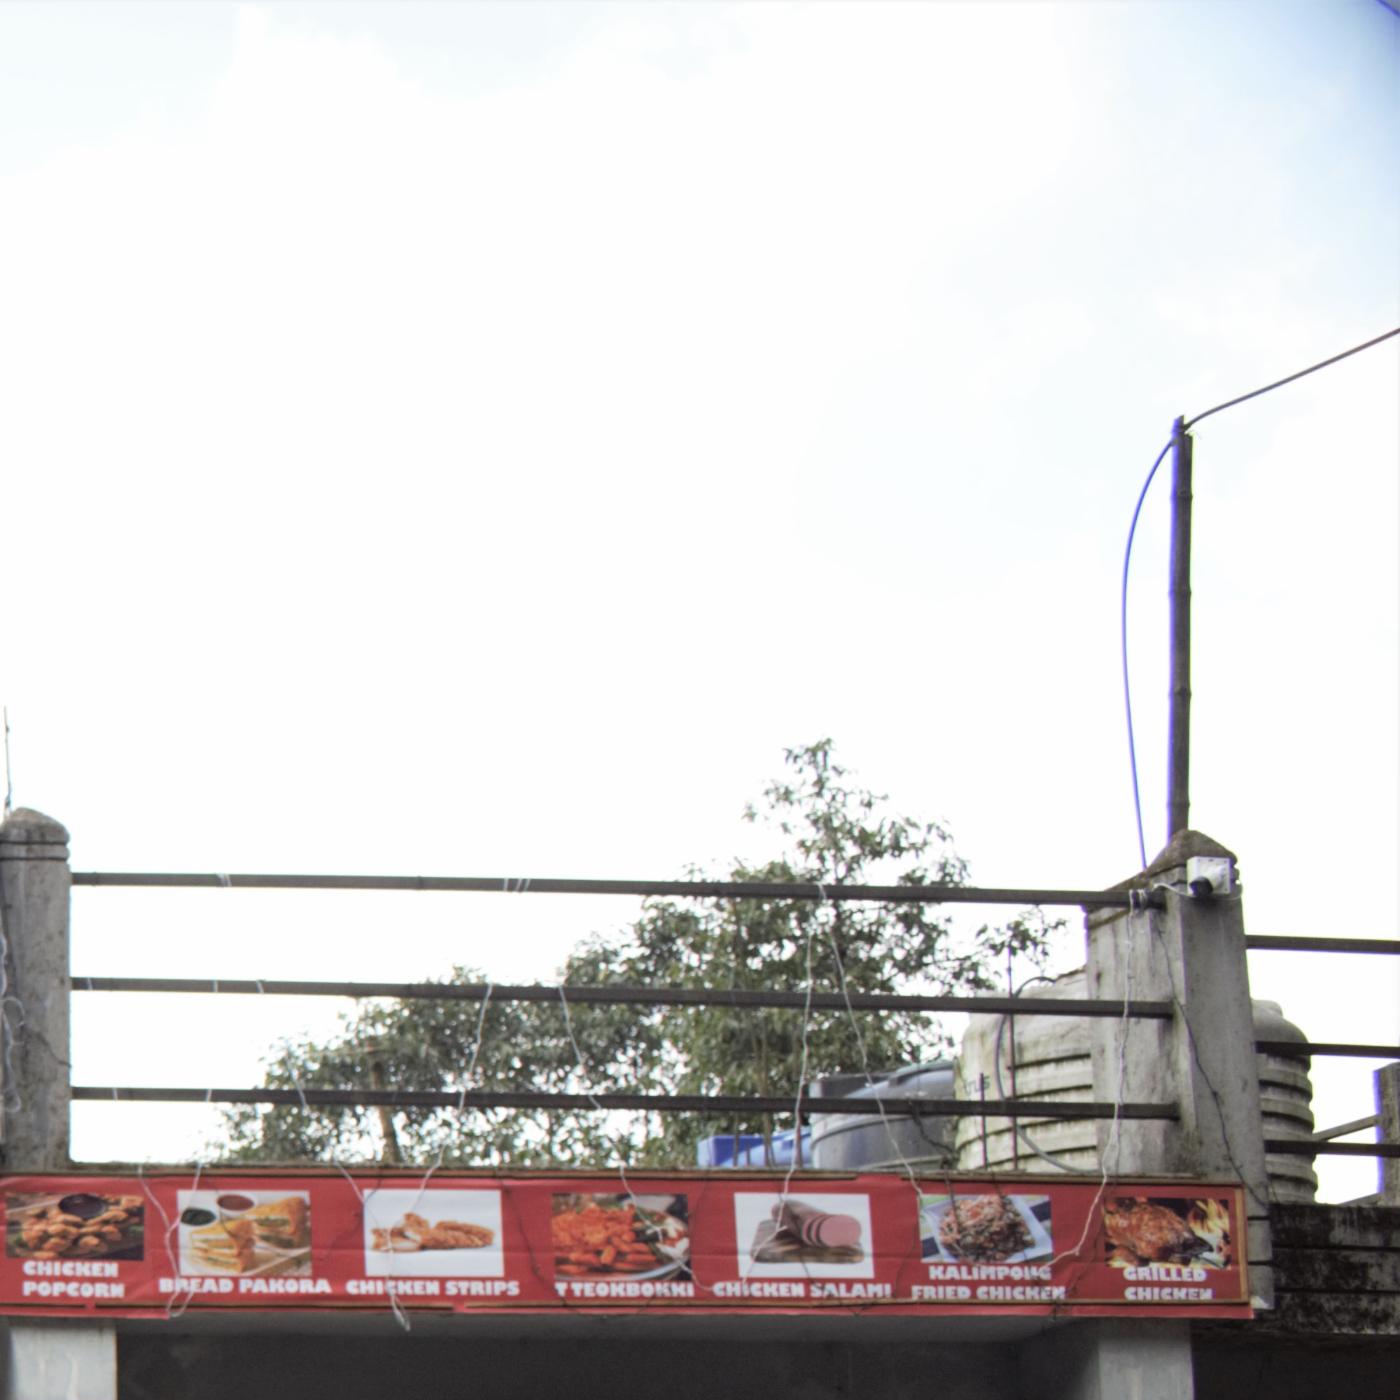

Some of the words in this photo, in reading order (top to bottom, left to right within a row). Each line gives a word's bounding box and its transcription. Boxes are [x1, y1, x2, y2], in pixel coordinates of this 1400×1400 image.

[23, 1260, 119, 1278] CHICKEN
[1123, 1265, 1207, 1282] GRILLED
[23, 1281, 125, 1298] POPCORN
[159, 1278, 234, 1293] BREAD
[240, 1278, 332, 1294] PAKORA
[346, 1280, 440, 1296] CHICKEN
[445, 1281, 520, 1297] STRIPS
[713, 1281, 804, 1297] CHICKEN
[810, 1282, 892, 1298] SALAMI
[912, 1285, 971, 1300] FRIED
[976, 1285, 1066, 1300] CHICKEN
[1124, 1286, 1215, 1301] CHICKEN
